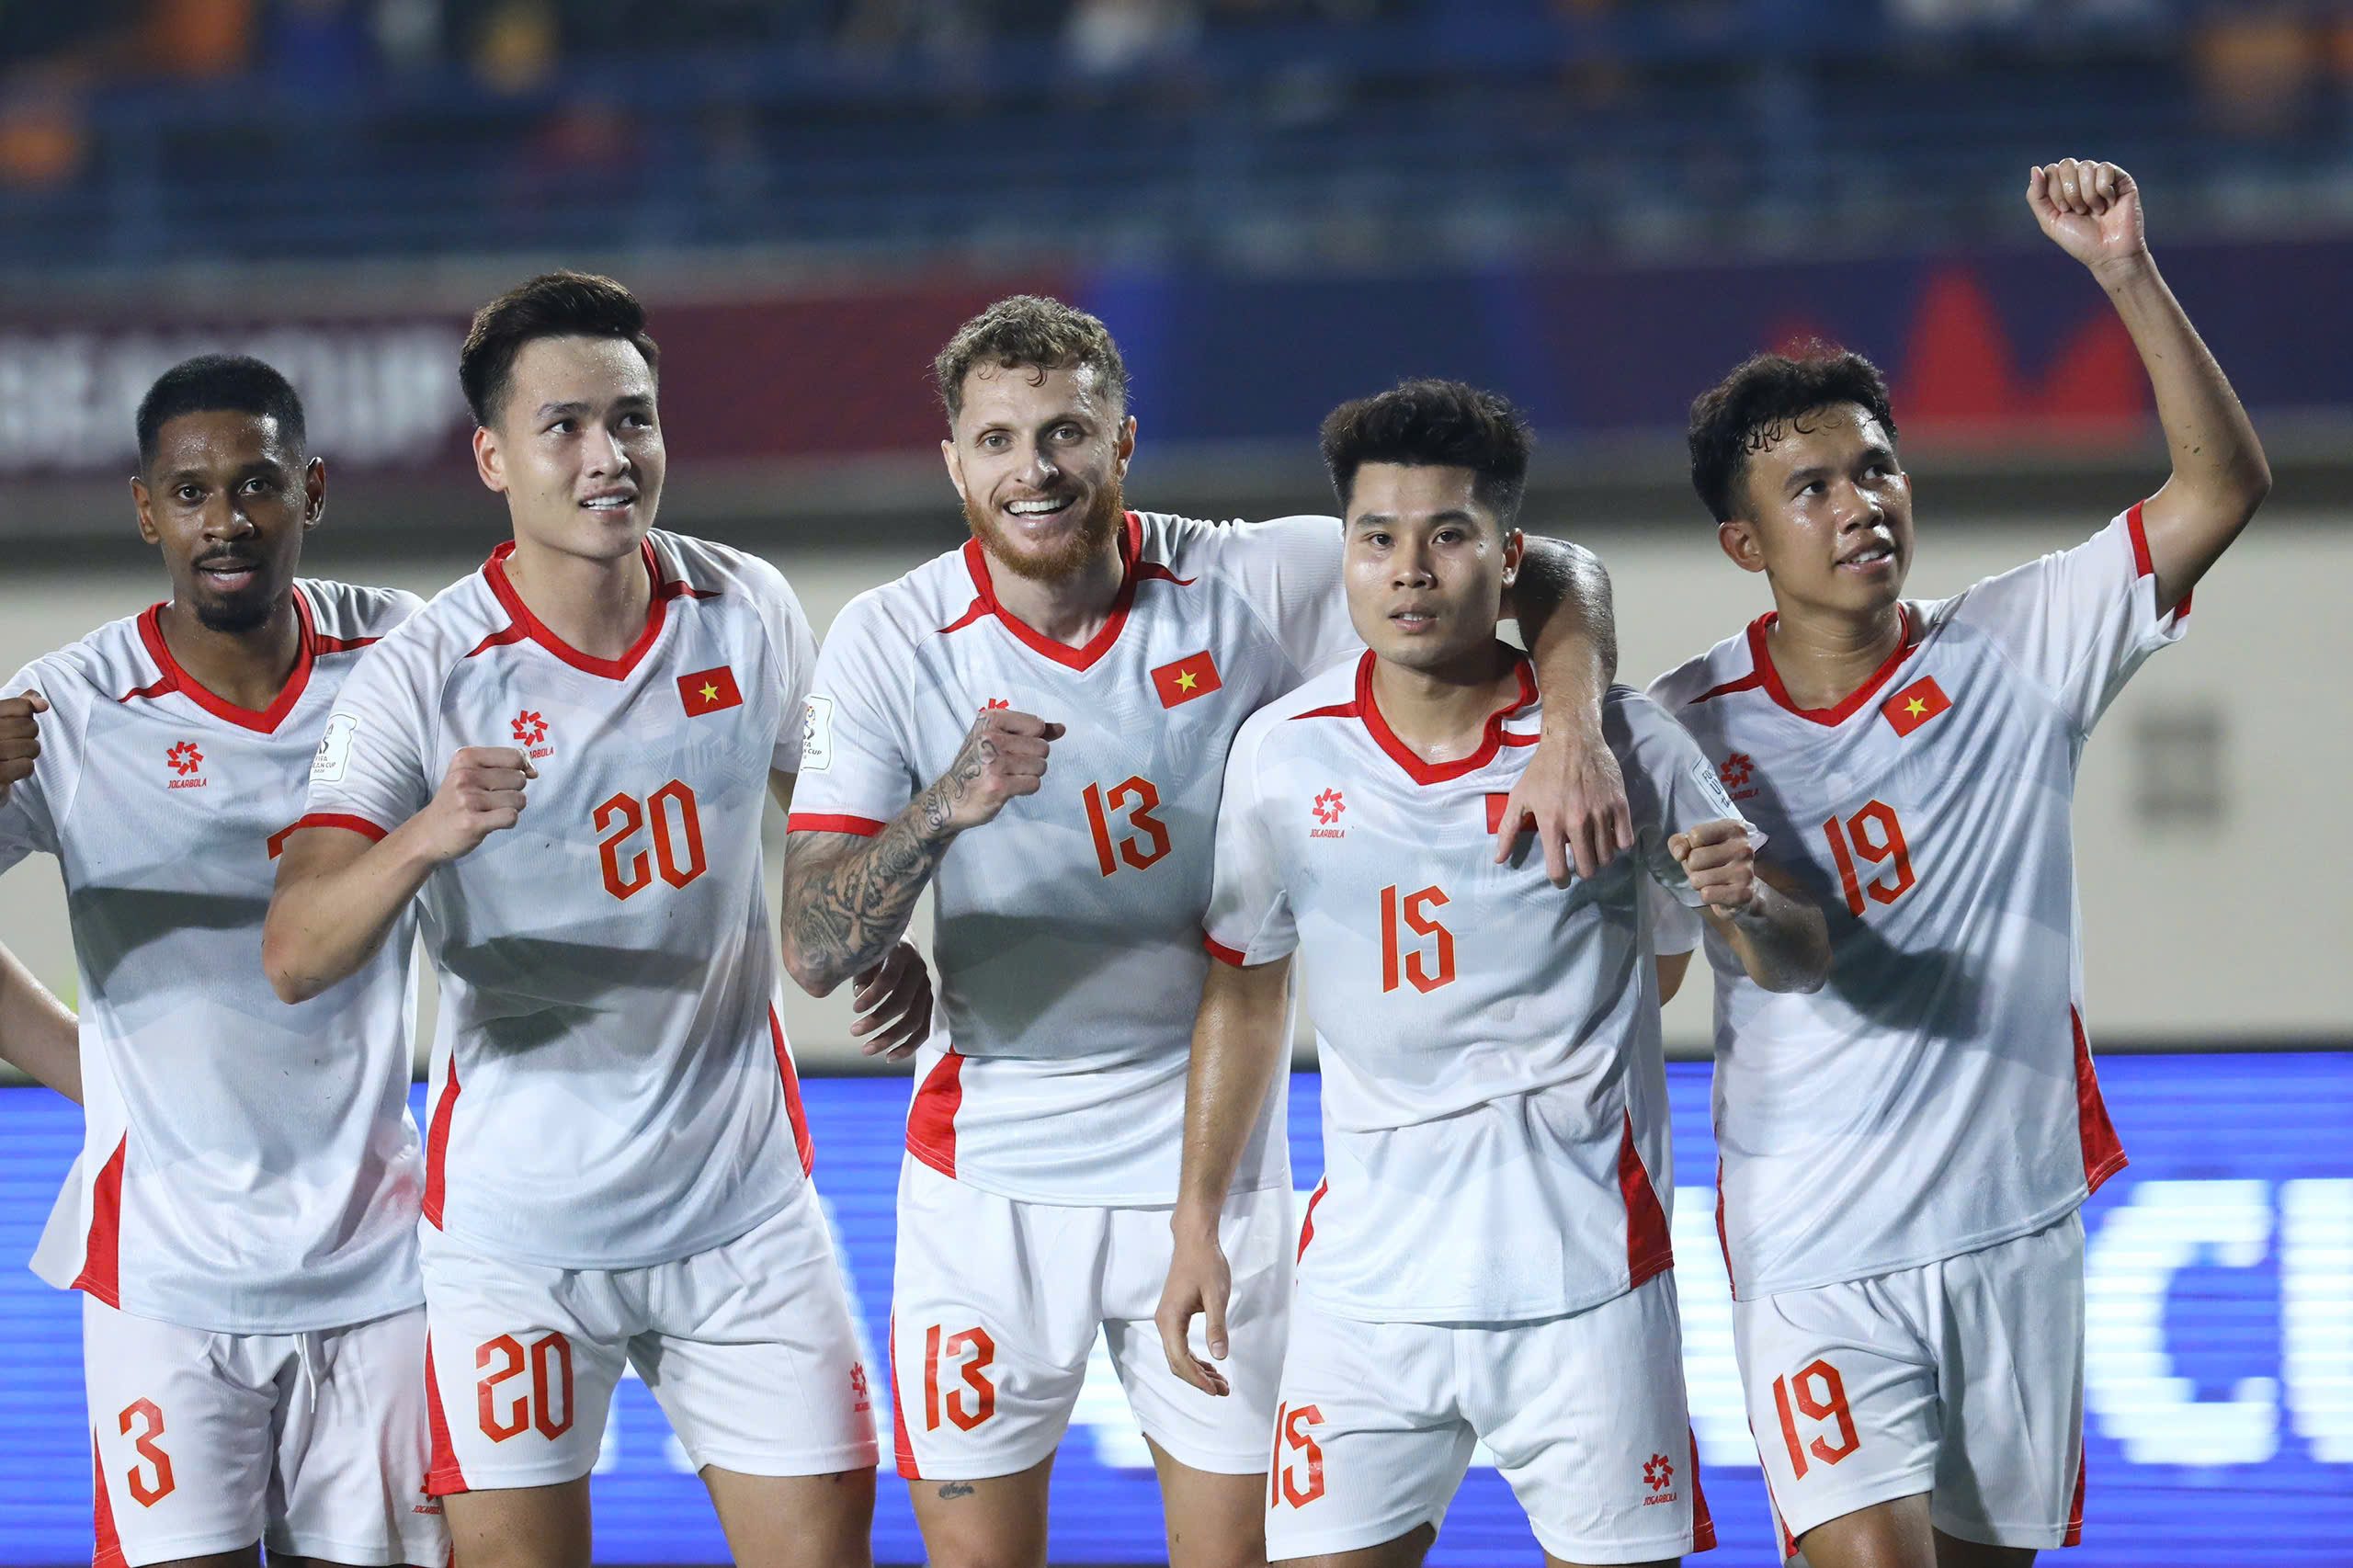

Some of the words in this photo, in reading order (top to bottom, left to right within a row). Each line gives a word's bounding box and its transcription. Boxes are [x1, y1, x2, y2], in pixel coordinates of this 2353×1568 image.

[591, 778, 708, 902] 20
[1080, 775, 1173, 879] 13
[1822, 798, 1916, 917] 19
[1380, 882, 1456, 994] 15
[475, 1331, 574, 1443] 20
[925, 1324, 995, 1432] 13
[1772, 1358, 1860, 1481] 19
[118, 1396, 176, 1508] 3
[1271, 1400, 1325, 1509] 15
